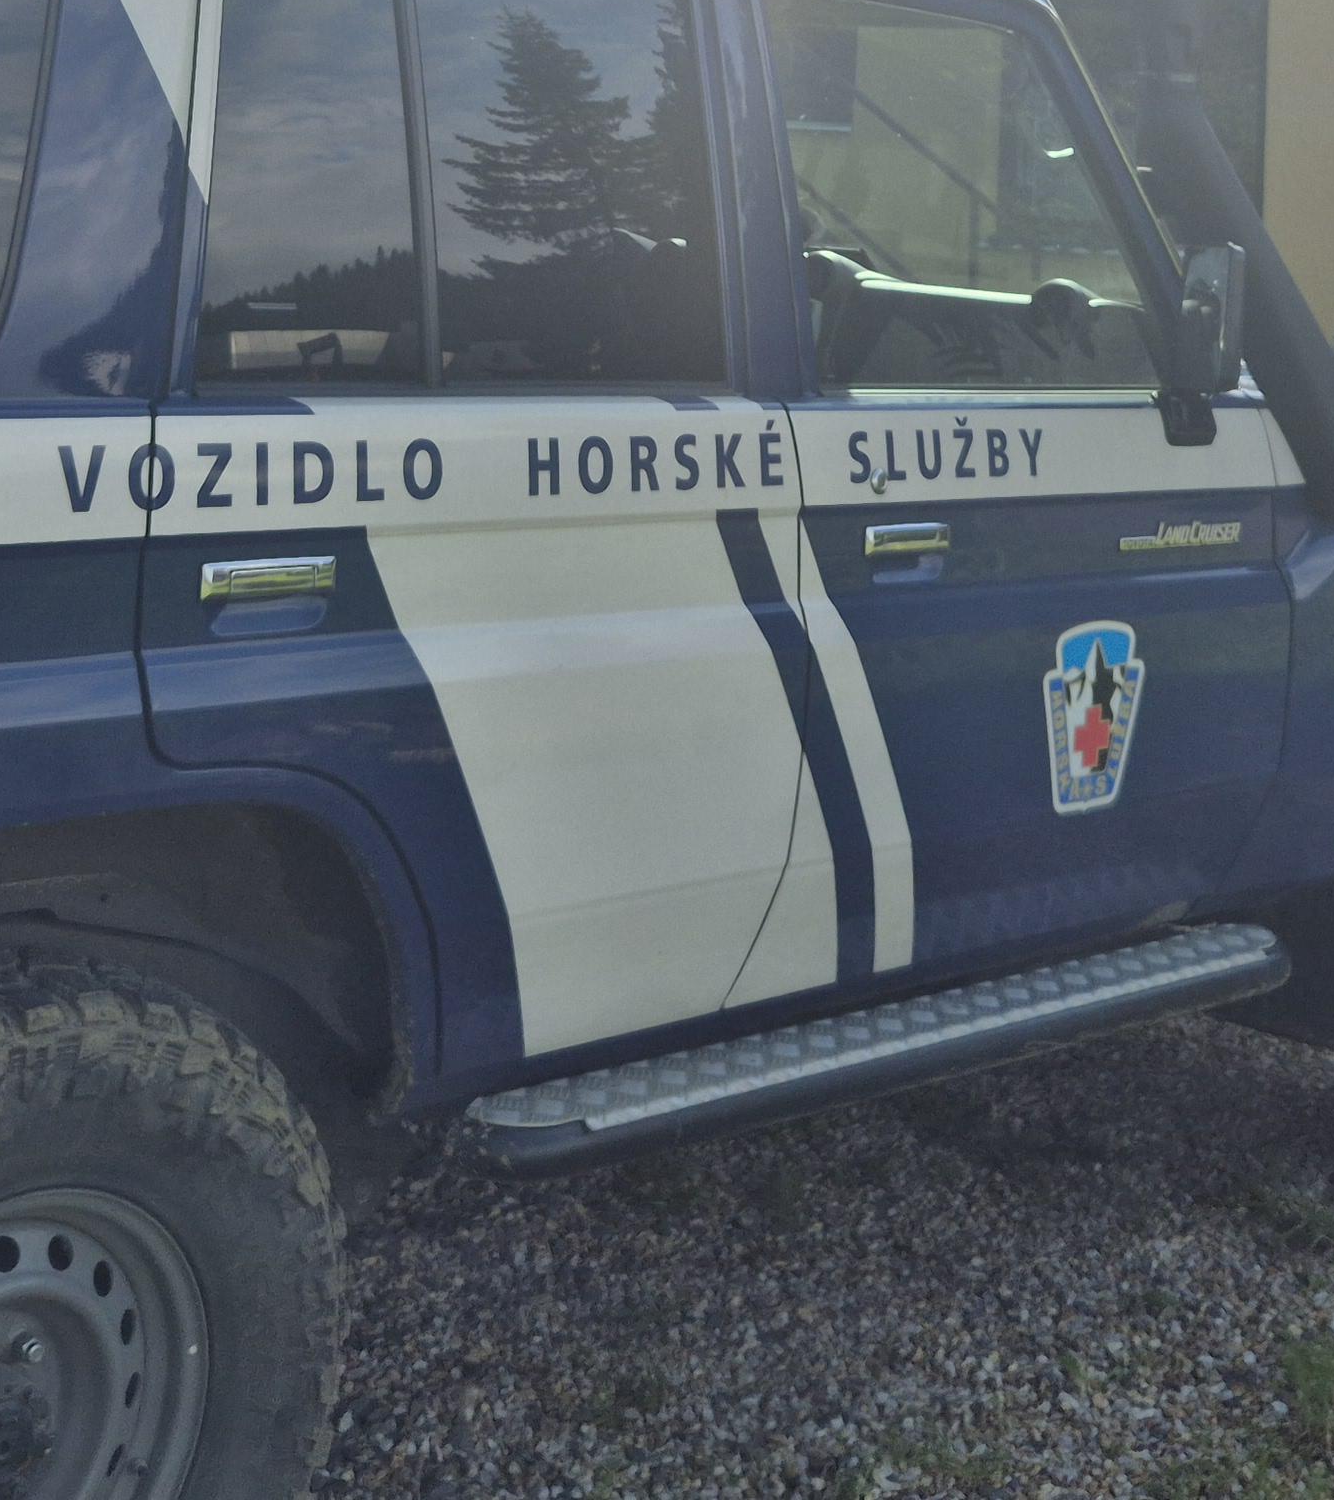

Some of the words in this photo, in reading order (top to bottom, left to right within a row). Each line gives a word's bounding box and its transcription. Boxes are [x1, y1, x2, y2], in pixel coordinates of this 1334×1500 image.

[58, 437, 444, 514] VOZIDLO
[527, 419, 785, 497] HORSKÉ
[848, 418, 1044, 484] SLUŽBY
